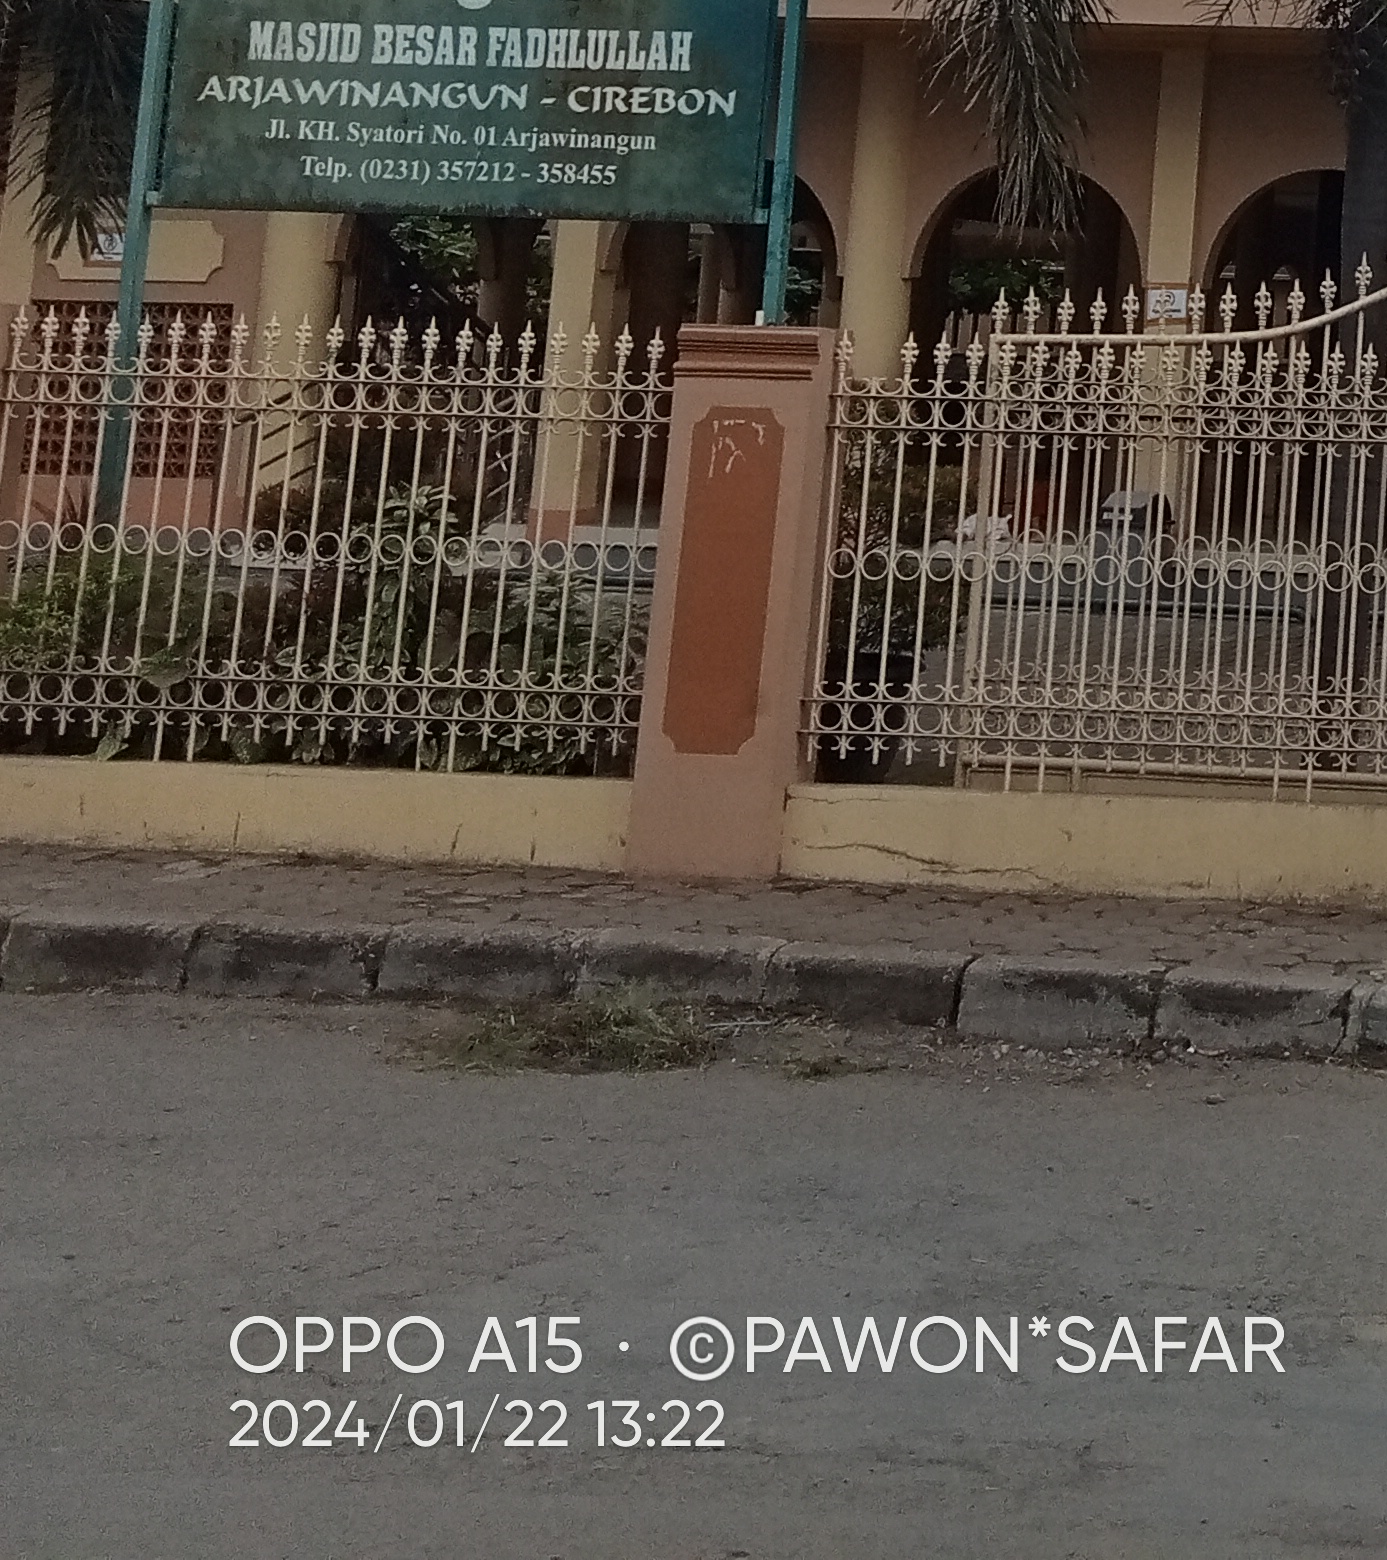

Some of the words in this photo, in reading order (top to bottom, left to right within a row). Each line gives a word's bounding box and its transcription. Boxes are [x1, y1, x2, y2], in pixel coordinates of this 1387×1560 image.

[248, 20, 362, 64] MASJID
[370, 23, 478, 67] BESAR
[486, 26, 694, 72] FADHLULLAH
[196, 74, 529, 111] ARJAWINANGUN
[566, 84, 738, 119] CIREBON
[264, 118, 291, 141] Jl.
[298, 120, 341, 142] KH.
[346, 122, 425, 148] Syatori
[430, 124, 468, 146] No.
[473, 125, 498, 147] 01
[501, 126, 657, 156] Arjawinangun
[300, 154, 353, 184] Telp.
[359, 158, 430, 186] (0231)
[436, 160, 516, 183] 357212
[536, 162, 617, 187] 358455
